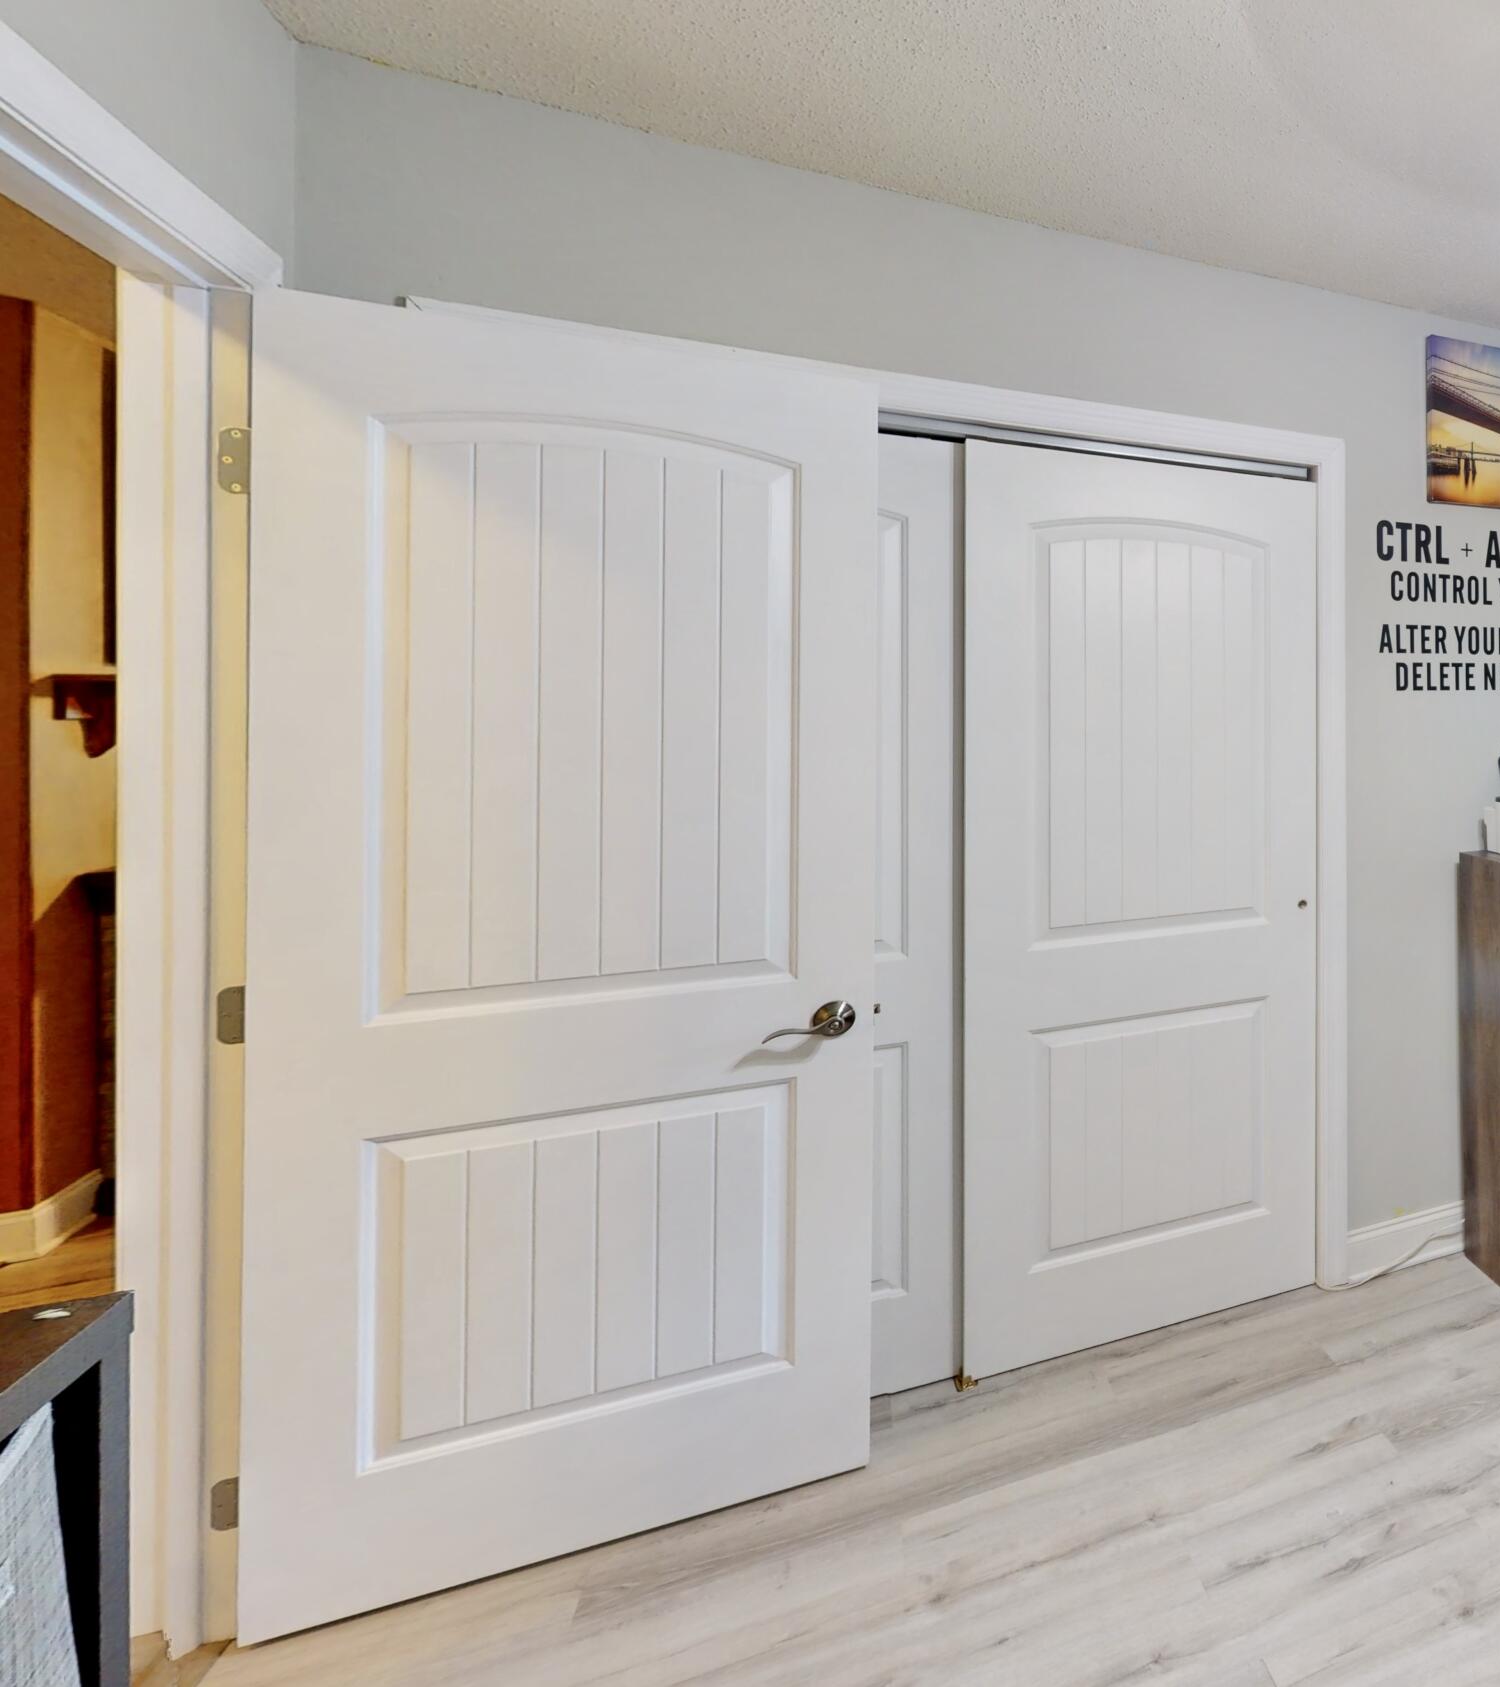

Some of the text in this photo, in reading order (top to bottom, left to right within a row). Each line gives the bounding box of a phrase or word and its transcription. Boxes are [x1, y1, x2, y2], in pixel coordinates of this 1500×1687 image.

[1376, 520, 1450, 565] CTRL
[1391, 570, 1492, 605] CONTROL
[1379, 624, 1447, 654] ALTER
[1396, 662, 1475, 691] DELETE
